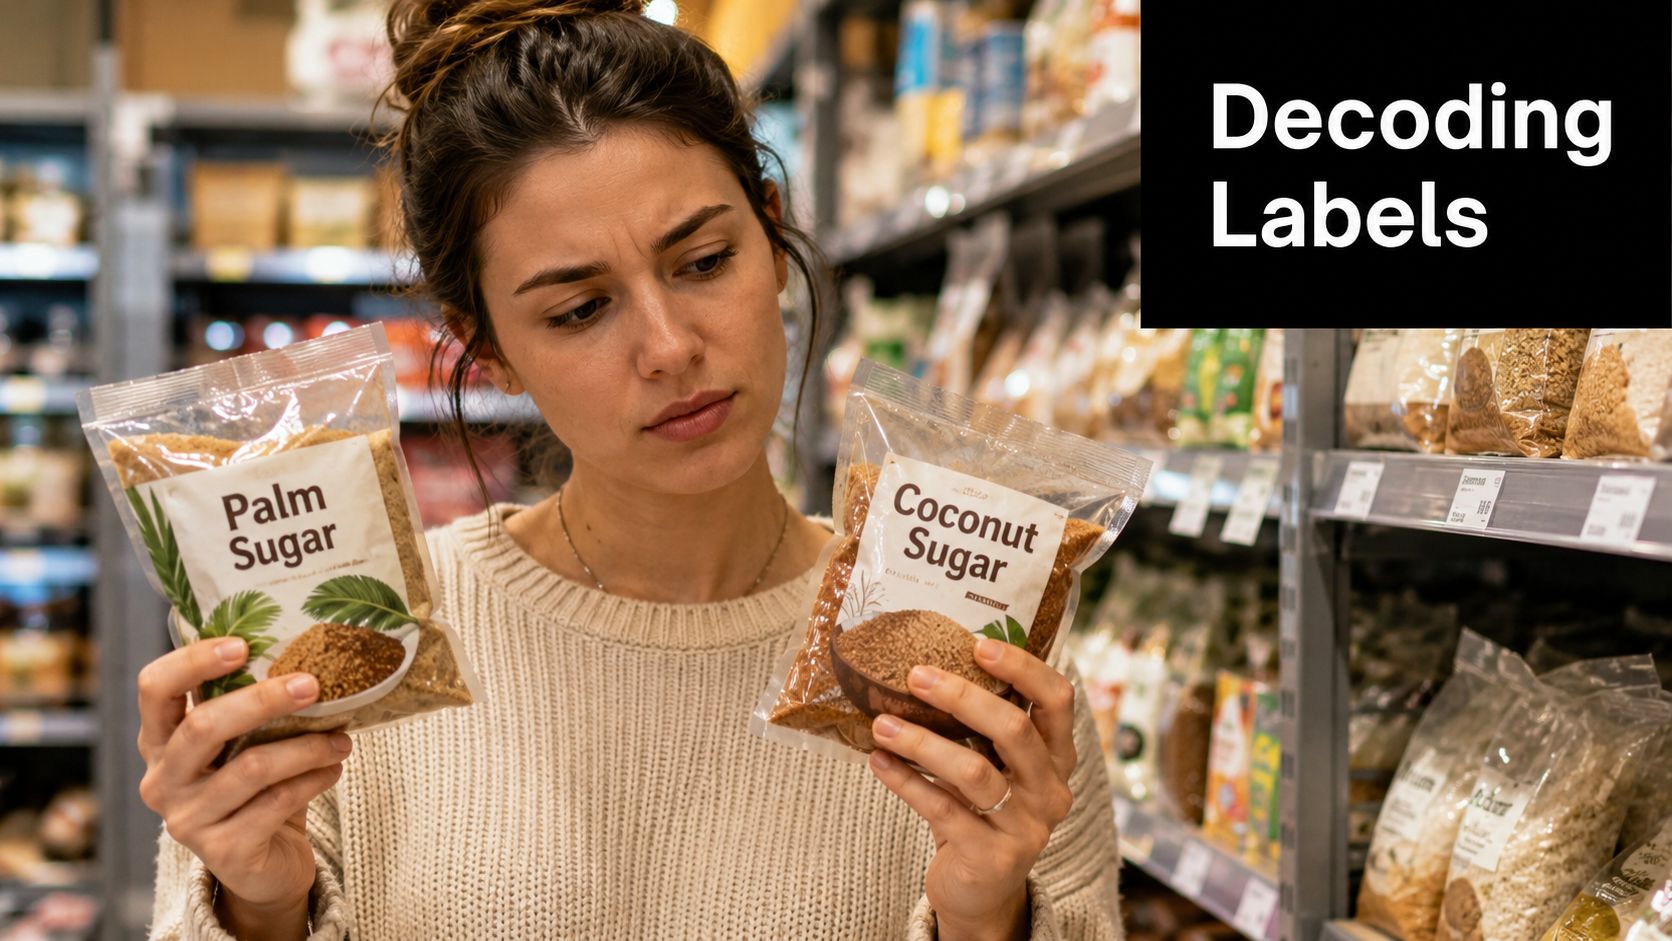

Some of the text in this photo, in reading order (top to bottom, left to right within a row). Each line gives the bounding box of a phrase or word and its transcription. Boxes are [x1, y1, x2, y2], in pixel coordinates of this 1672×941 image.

[221, 482, 327, 531] Palm
[893, 483, 1039, 554] Coconut
[229, 523, 336, 570] Sugar
[903, 526, 1008, 583] Sugar
